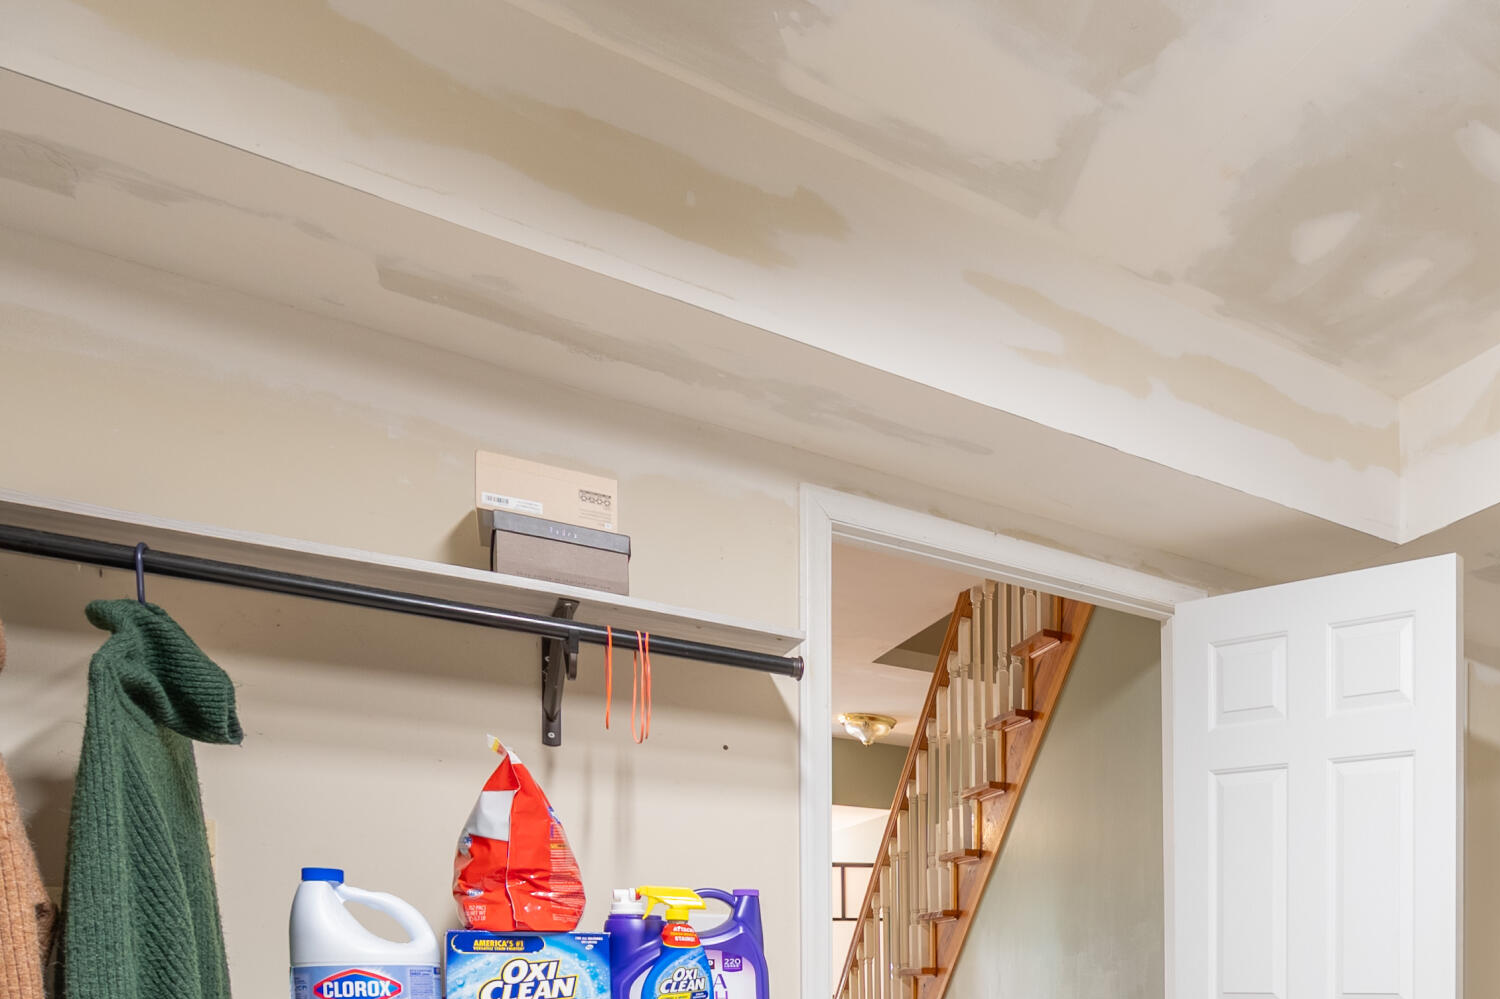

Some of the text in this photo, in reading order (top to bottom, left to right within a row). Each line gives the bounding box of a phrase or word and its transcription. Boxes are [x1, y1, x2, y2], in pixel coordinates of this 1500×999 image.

[473, 939, 514, 947] AMERICA'S
[502, 958, 559, 984] OXI
[673, 967, 698, 981] OXI
[322, 980, 392, 998] CLOROX
[660, 978, 706, 993] CLEAN
